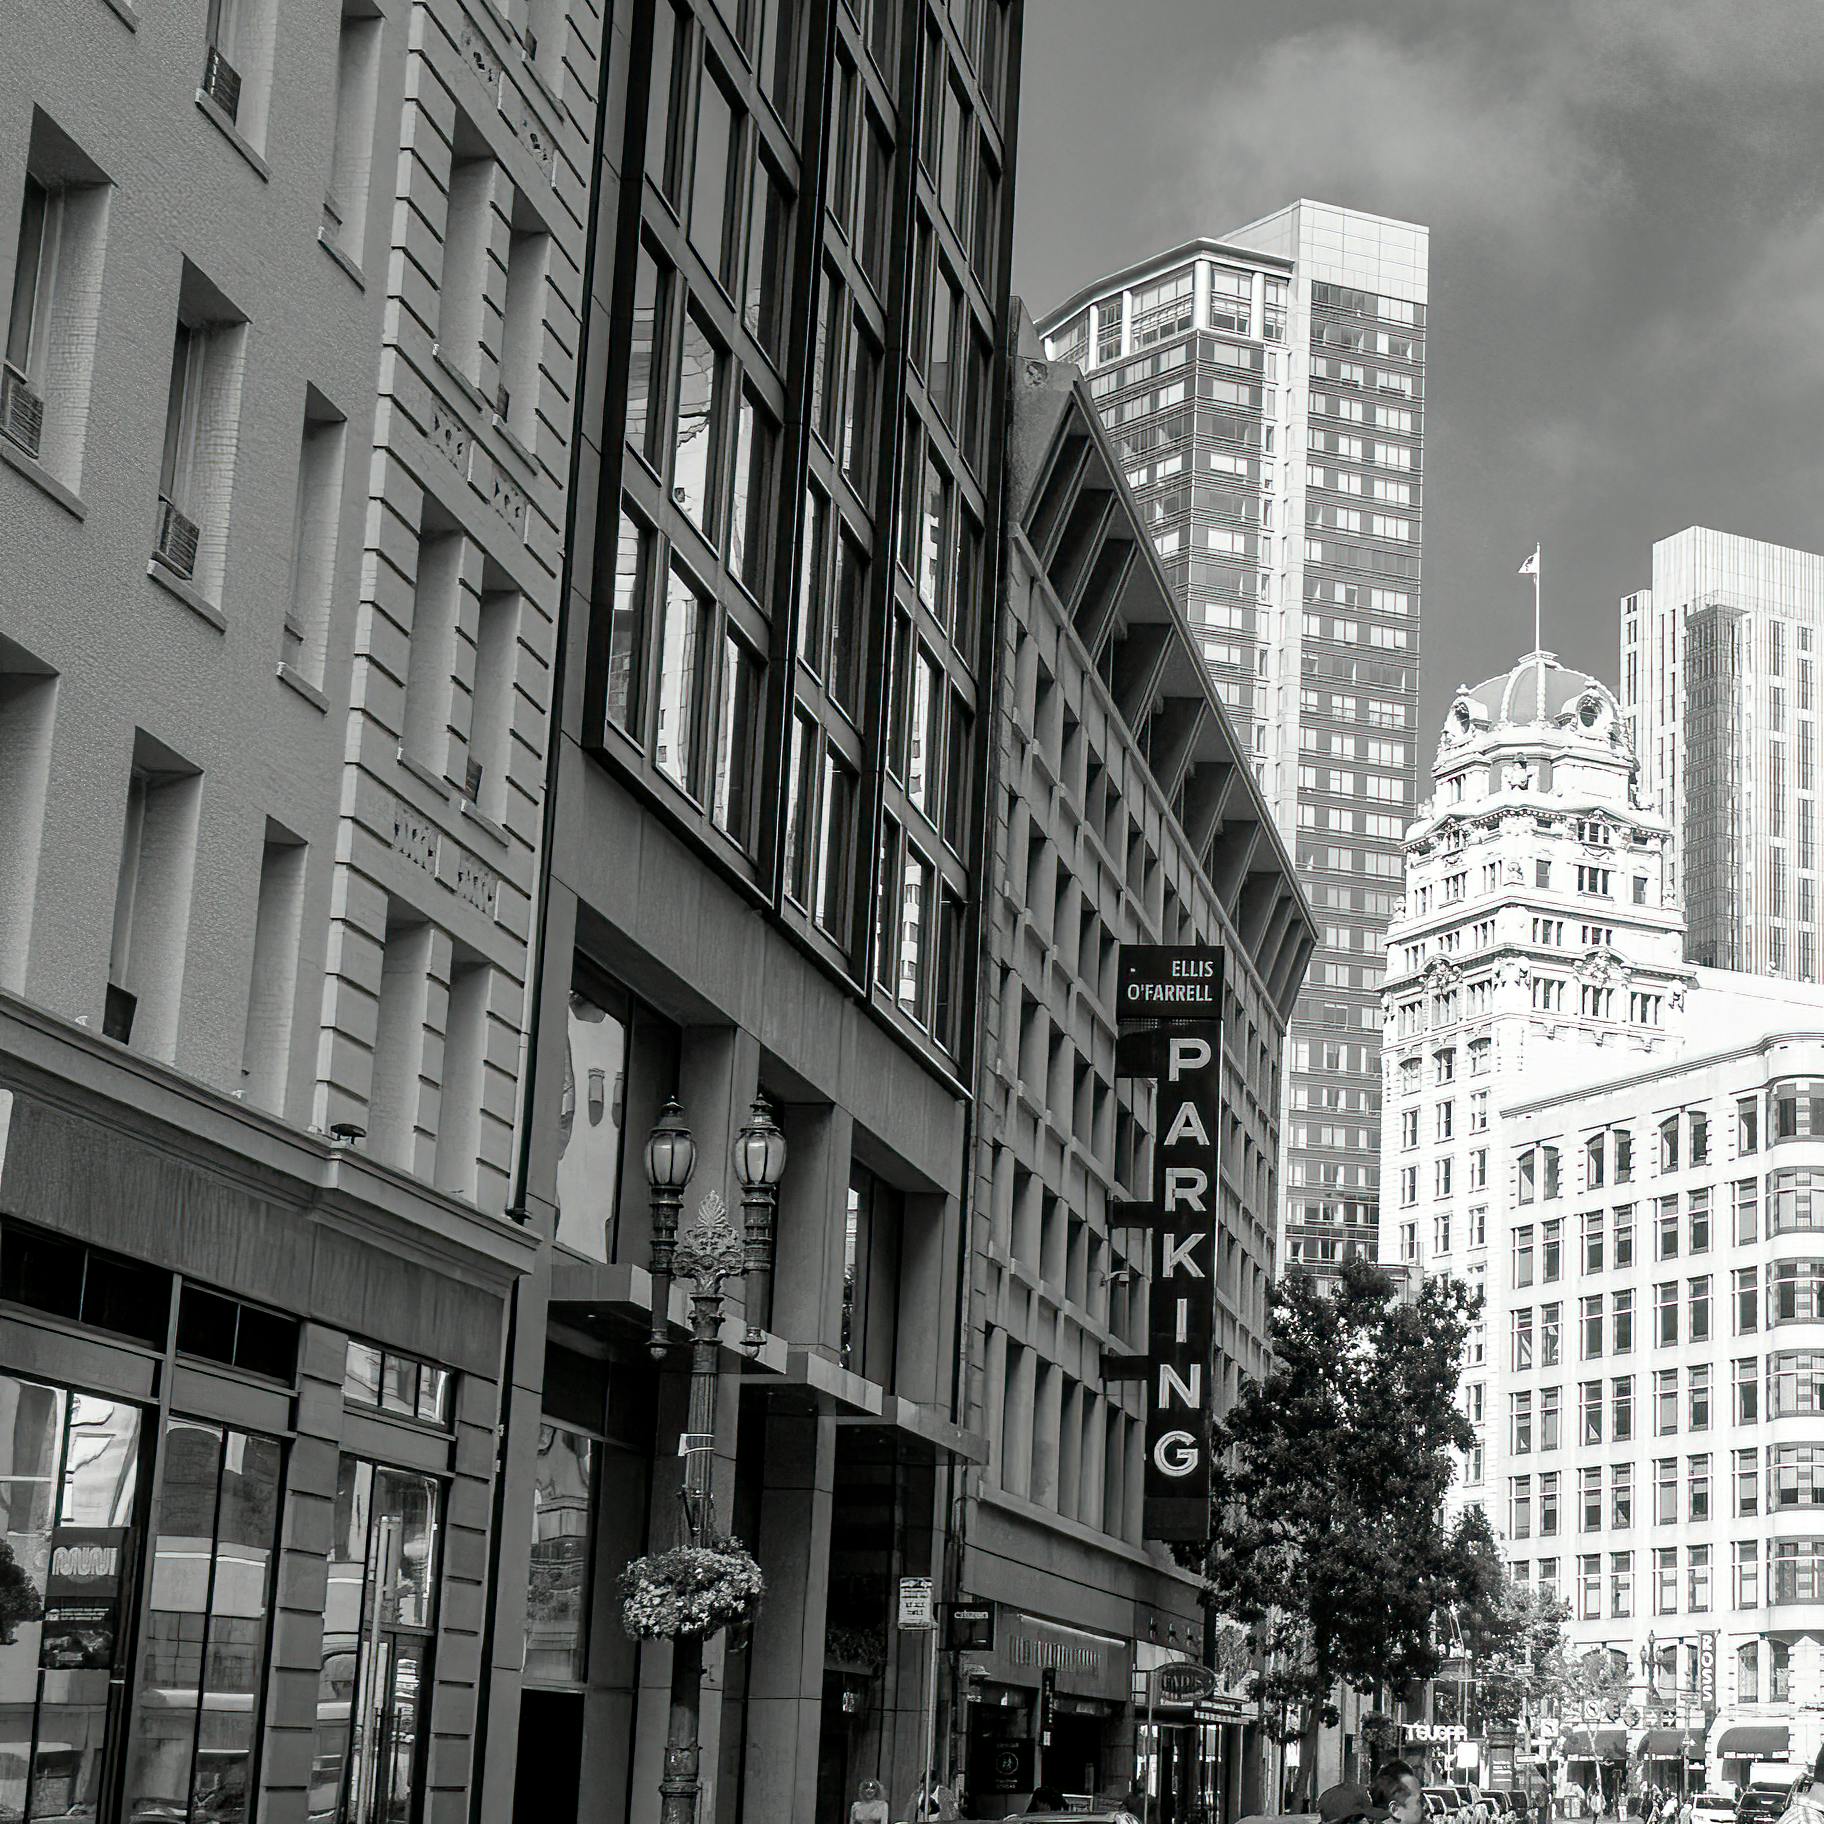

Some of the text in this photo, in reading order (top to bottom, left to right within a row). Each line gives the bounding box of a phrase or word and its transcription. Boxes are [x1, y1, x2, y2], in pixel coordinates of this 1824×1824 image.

[1172, 961, 1214, 977] ELLIS
[1127, 984, 1213, 1002] O'FARRELL
[1154, 1038, 1211, 1476] PARKING
[1701, 1634, 1714, 1702] ROSS
